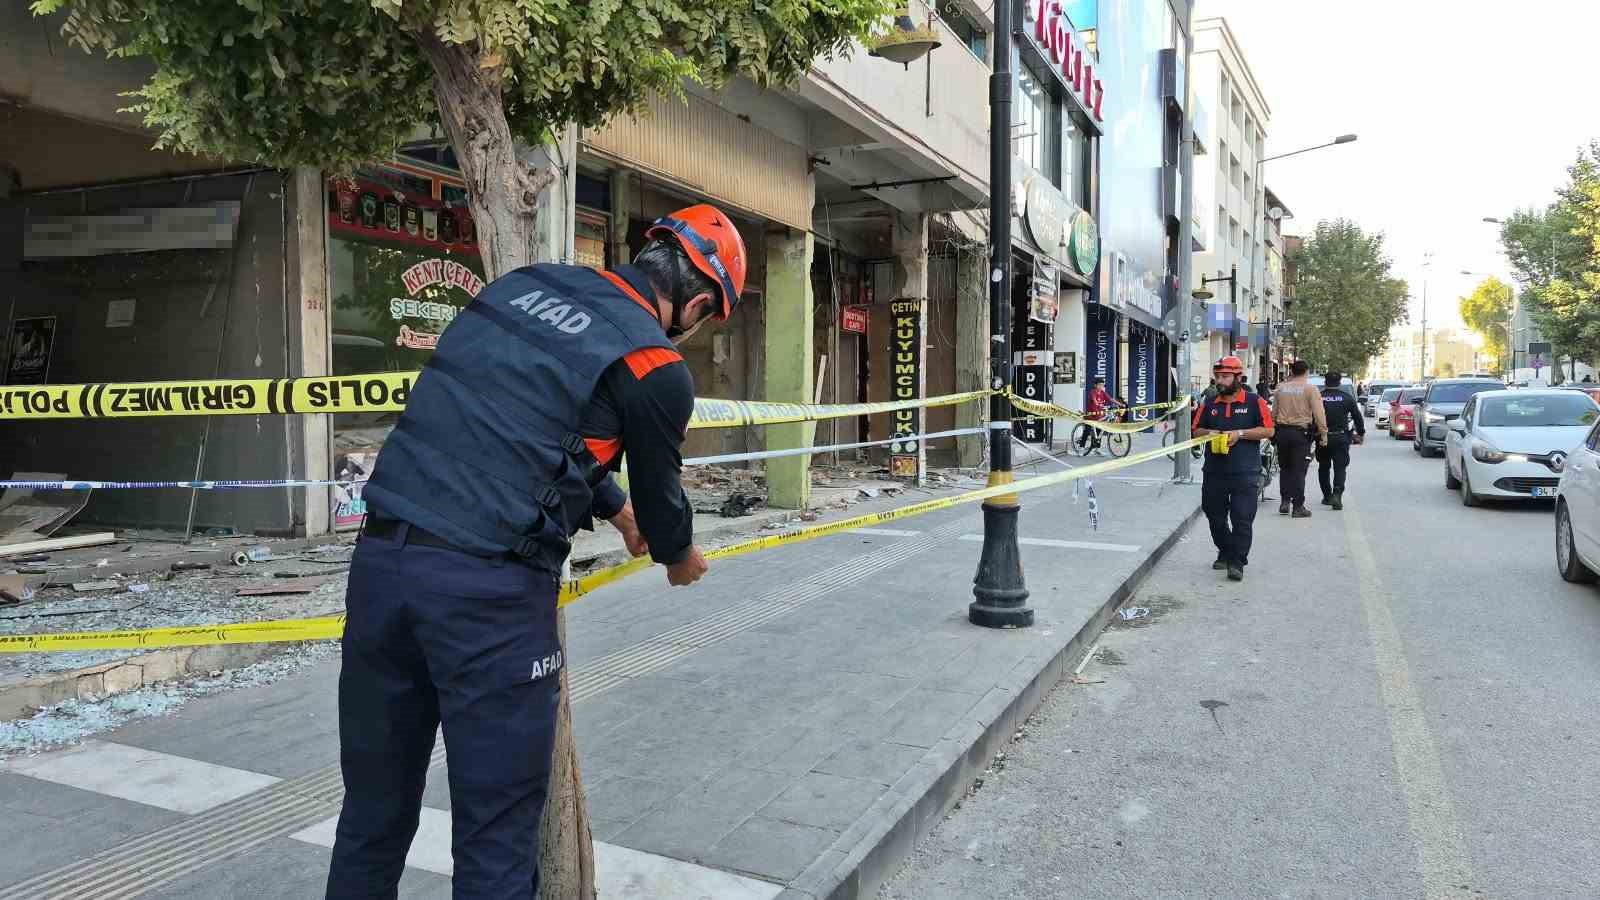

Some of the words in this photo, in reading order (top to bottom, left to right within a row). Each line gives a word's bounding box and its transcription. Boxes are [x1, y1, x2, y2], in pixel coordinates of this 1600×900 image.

[402, 260, 442, 295] KENT
[443, 260, 487, 298] ÇERE
[509, 290, 591, 334] AFAD
[307, 378, 410, 407] POLİS
[896, 317, 914, 433] KUYUMCUUK
[0, 390, 70, 413] POLİ
[109, 384, 256, 412] GİRİLMEZ
[1025, 372, 1036, 439] DÖER
